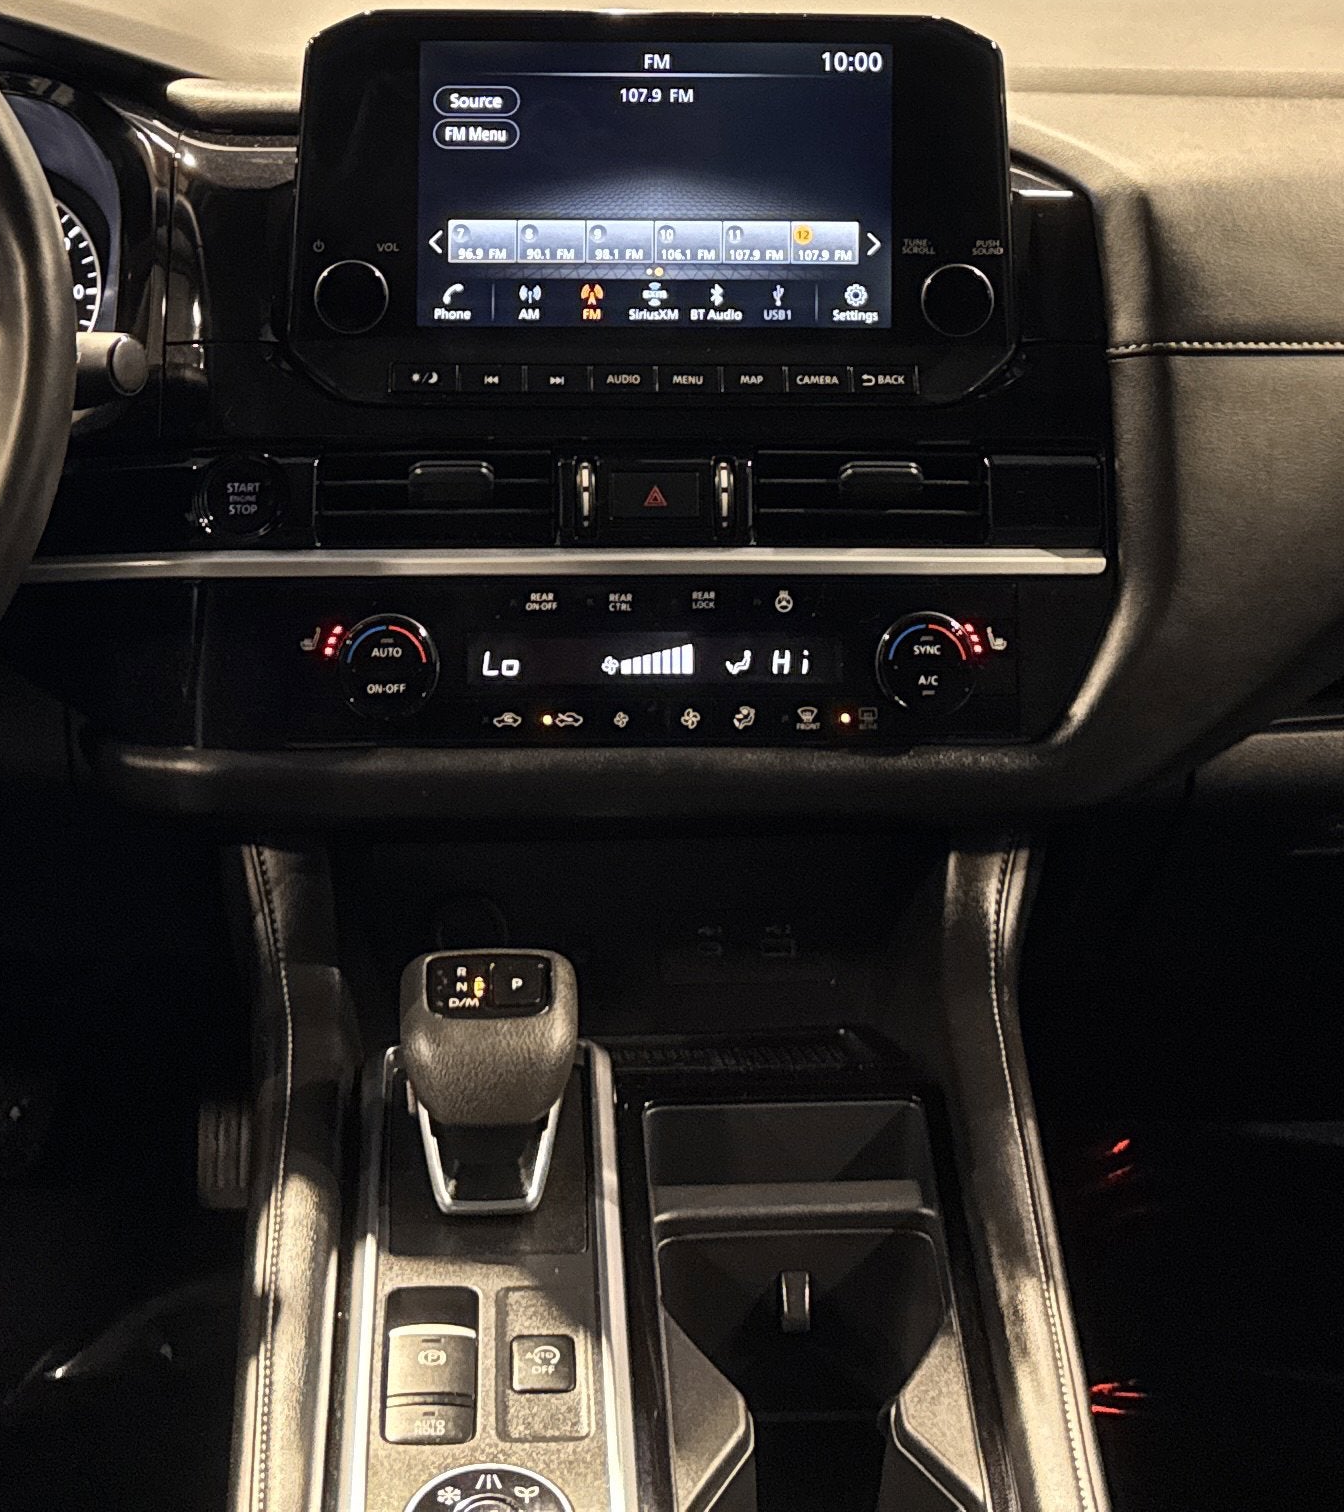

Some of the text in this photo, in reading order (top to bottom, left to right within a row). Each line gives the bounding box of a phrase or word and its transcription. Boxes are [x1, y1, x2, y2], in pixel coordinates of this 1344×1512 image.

[643, 53, 671, 70] FM
[821, 51, 883, 72] 10:00
[449, 92, 503, 109] Source
[620, 88, 694, 103] 107.9 FM
[444, 126, 507, 142] FM Menu
[456, 228, 466, 240] 7
[524, 228, 534, 240] 8
[593, 228, 603, 240] 9
[660, 229, 675, 241] 10
[728, 229, 742, 241] 11
[797, 230, 810, 241] 12
[377, 243, 400, 252] VOL
[976, 239, 1001, 248] PUSH
[458, 248, 507, 260] 96.9 FM
[526, 248, 575, 260] 90.1 FM
[595, 248, 644, 260] 98.1 FM
[661, 249, 716, 261] 106.1 FM
[729, 249, 784, 262] 107.9 FM
[798, 250, 853, 262] 107.9 FM
[902, 247, 936, 255] SCROLL
[972, 247, 1004, 256] SOUND
[434, 308, 472, 321] Phone
[518, 308, 540, 320] AM
[582, 308, 602, 321] FM
[628, 308, 679, 322] SiriusXM
[690, 309, 743, 322] BT Audio
[763, 309, 792, 321] USB1
[832, 309, 879, 324] Settings
[606, 374, 641, 385] AUDIO
[672, 374, 704, 385] MENU
[740, 375, 764, 385] MAP
[796, 374, 839, 385] CAMERA
[877, 375, 905, 385] BACK
[226, 482, 261, 494] START
[229, 494, 256, 503] ENGINE
[228, 504, 258, 516] STOP
[530, 592, 555, 602] REAR
[609, 593, 633, 603] REAR
[692, 591, 716, 600] REAR
[609, 602, 633, 612] CTRL
[692, 600, 716, 610] LOCK
[371, 647, 402, 658] AUTO
[913, 645, 942, 656] SYNC
[482, 650, 520, 677] Lo
[772, 649, 810, 675] Hi
[918, 674, 939, 687] A/C
[796, 722, 821, 731] FRONT
[457, 966, 467, 978] R
[456, 981, 468, 993] N
[511, 977, 523, 991] P
[448, 997, 480, 1009] D/M
[531, 1364, 556, 1376] OFF
[414, 1419, 446, 1428] AUTO
[415, 1426, 446, 1436] HOLD
